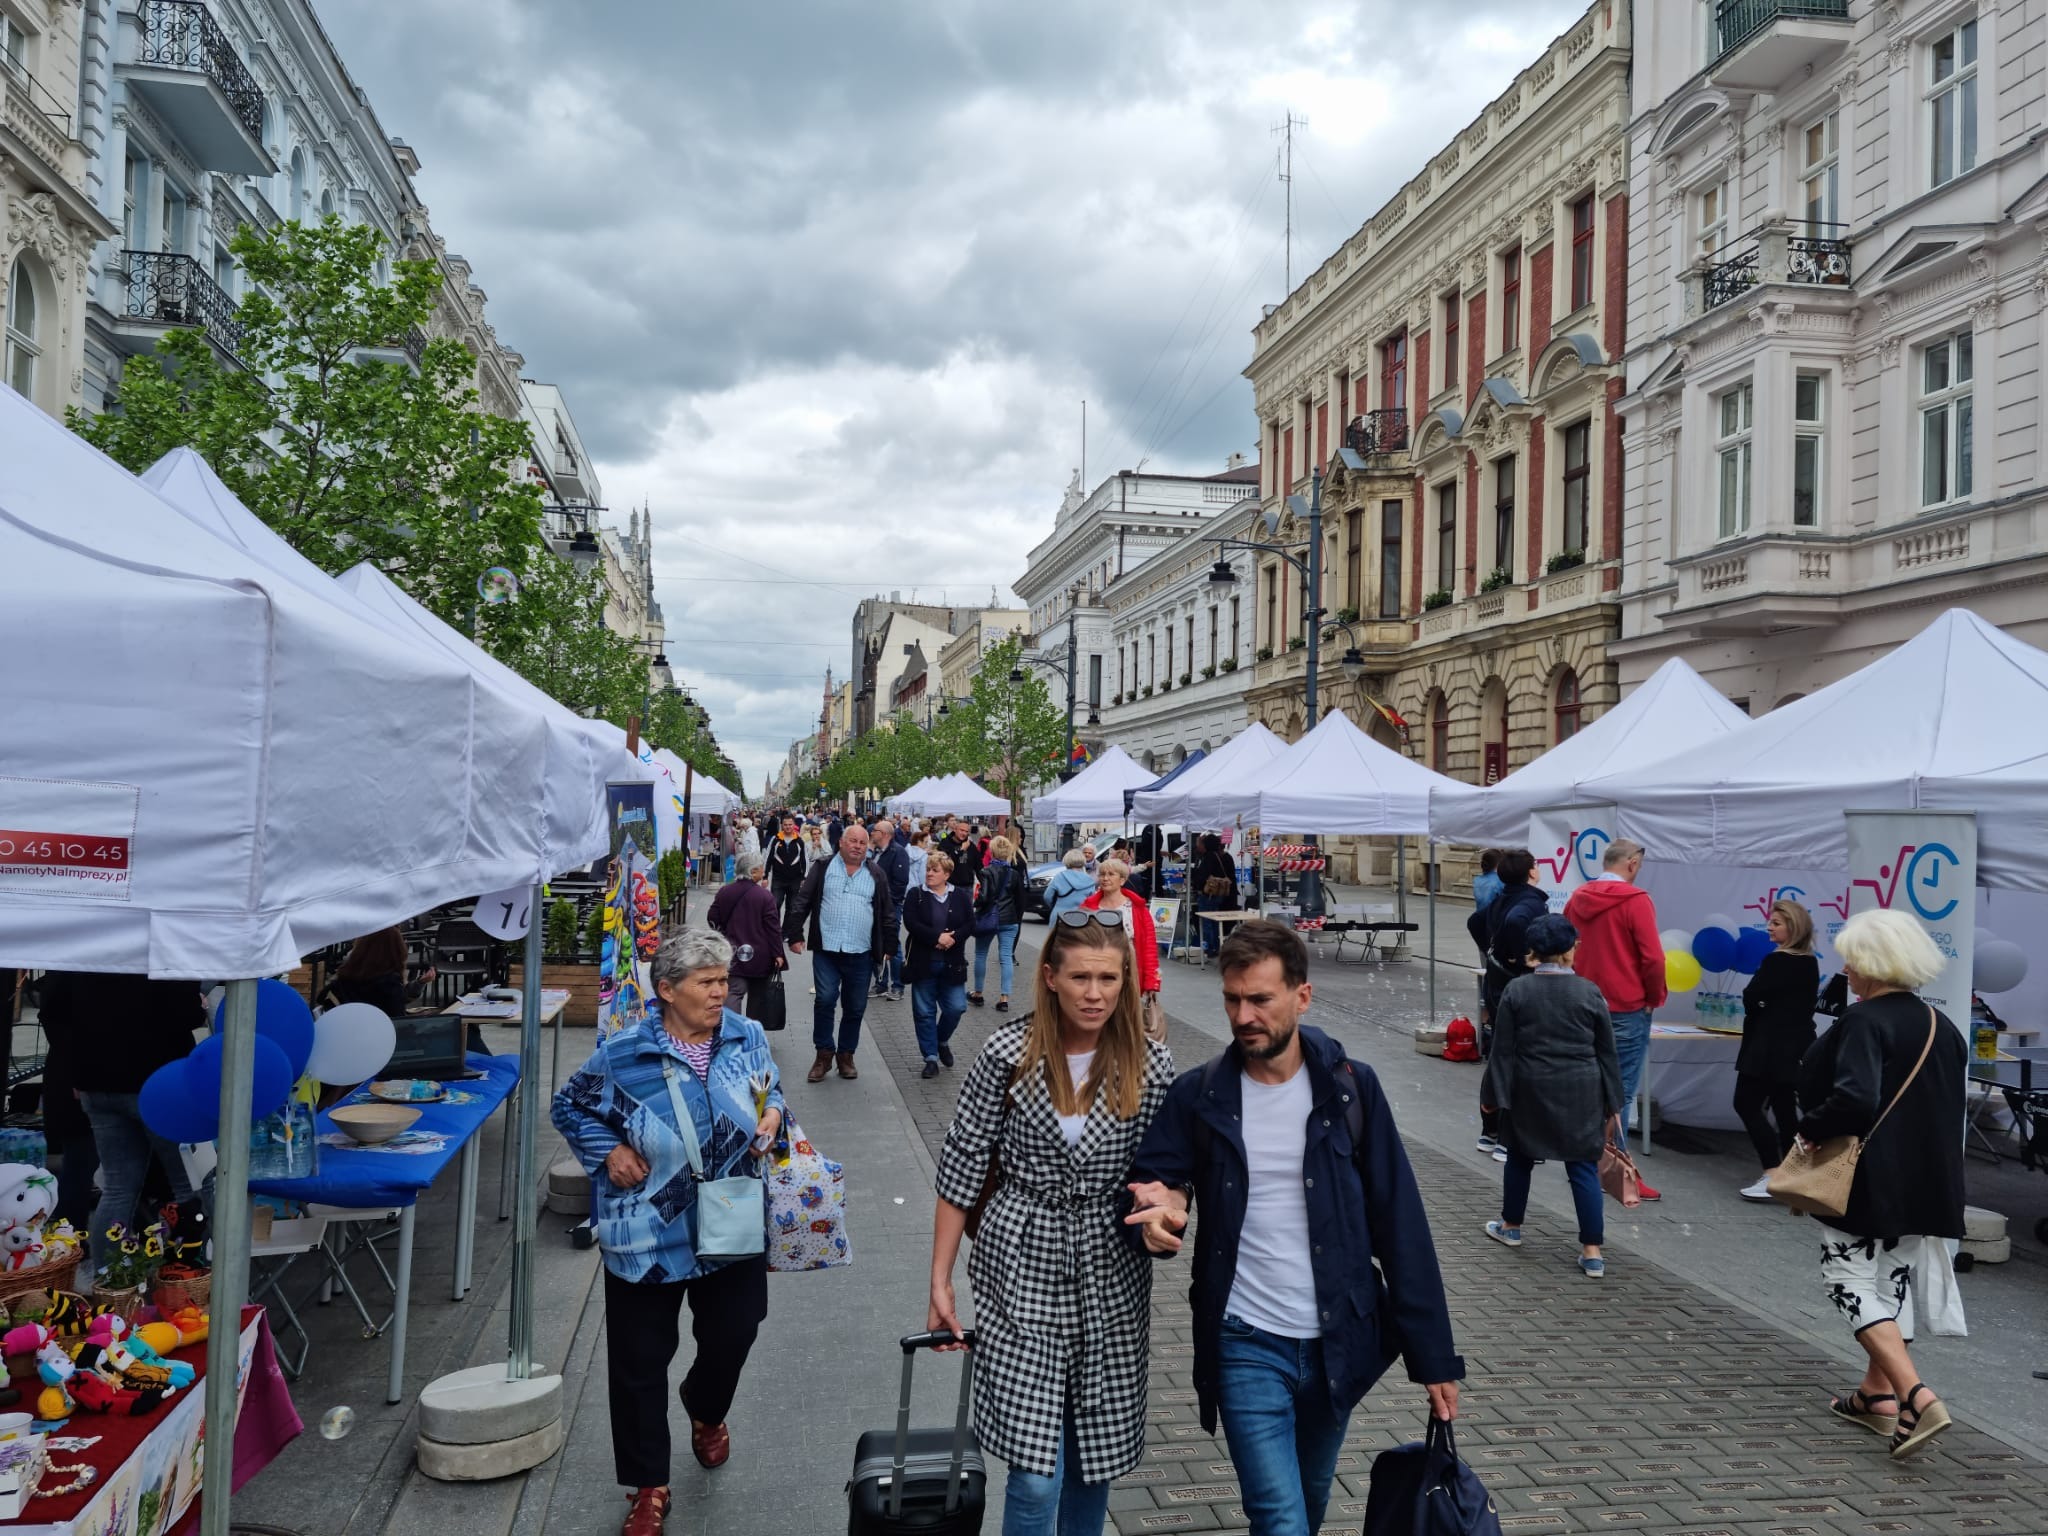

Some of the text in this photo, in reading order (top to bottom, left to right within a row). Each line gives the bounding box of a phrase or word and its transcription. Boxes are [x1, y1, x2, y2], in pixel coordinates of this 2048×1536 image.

[22, 841, 52, 858] 45
[59, 842, 86, 859] 10
[93, 846, 123, 861] 45
